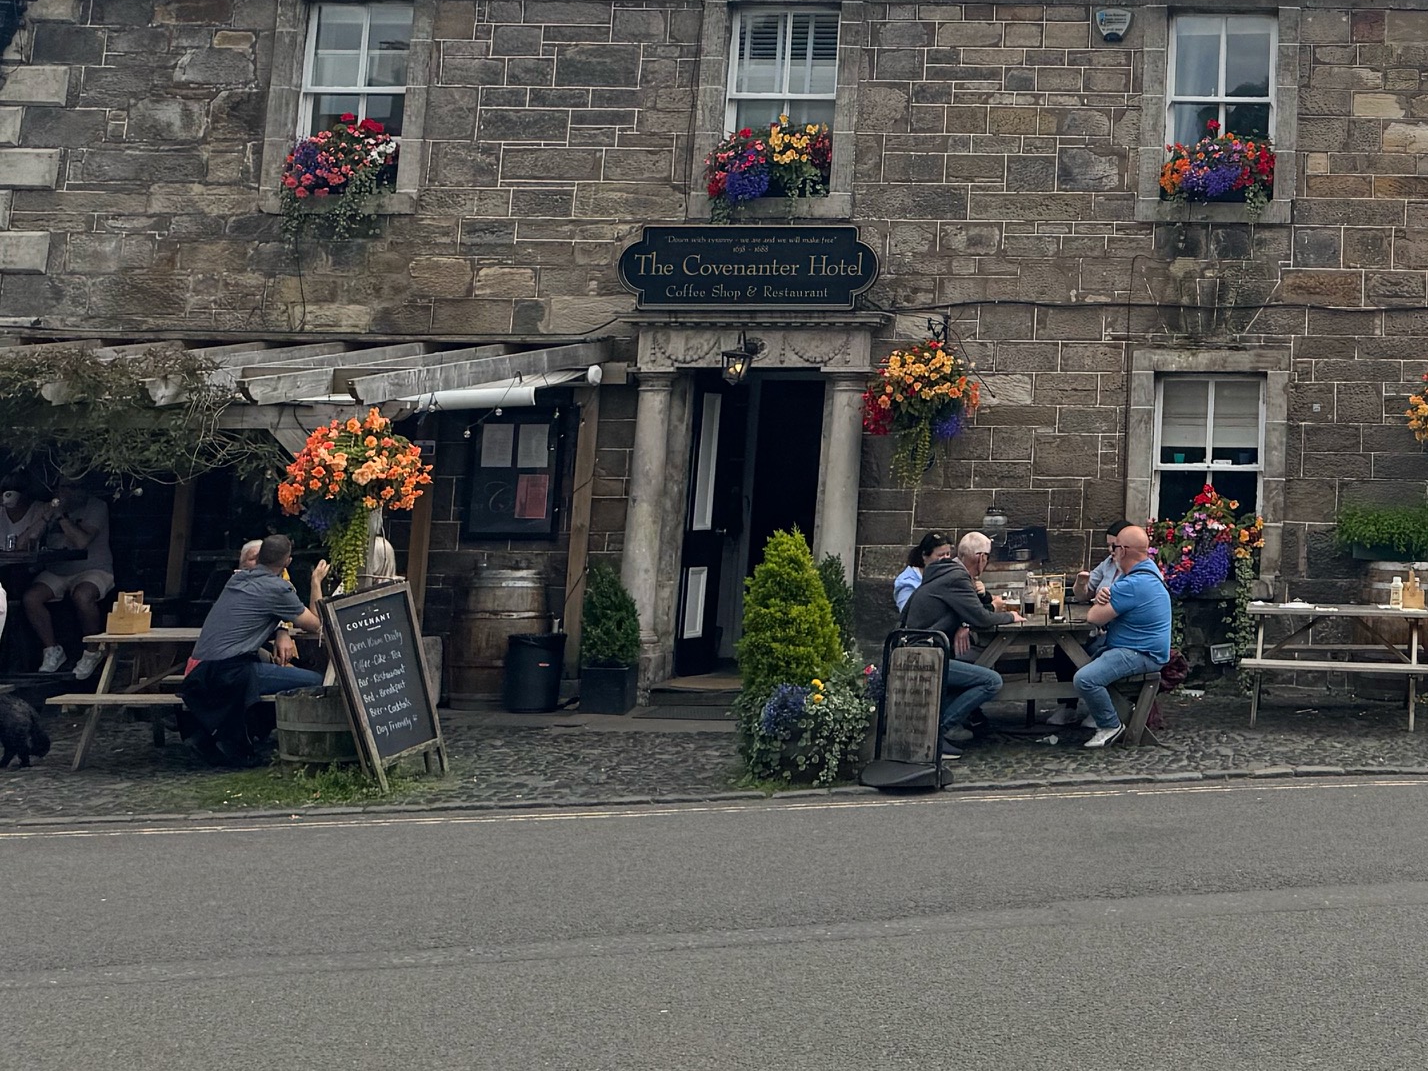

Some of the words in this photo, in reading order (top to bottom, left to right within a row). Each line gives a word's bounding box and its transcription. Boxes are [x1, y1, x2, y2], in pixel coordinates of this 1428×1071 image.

[691, 236, 706, 244] with
[707, 237, 734, 245] tyranny
[763, 236, 776, 244] and
[788, 236, 800, 244] will
[802, 236, 820, 244] make
[634, 251, 674, 276] The
[683, 254, 800, 276] Covenanter
[808, 251, 863, 276] Hotel
[666, 283, 706, 298] Coffee
[711, 284, 741, 301] Shop
[746, 286, 758, 298] &
[763, 286, 828, 298] Restaurant
[346, 612, 391, 631] COVENANT
[363, 691, 376, 704] Bed
[376, 725, 390, 737] Dog
[388, 716, 413, 732] Friendly
